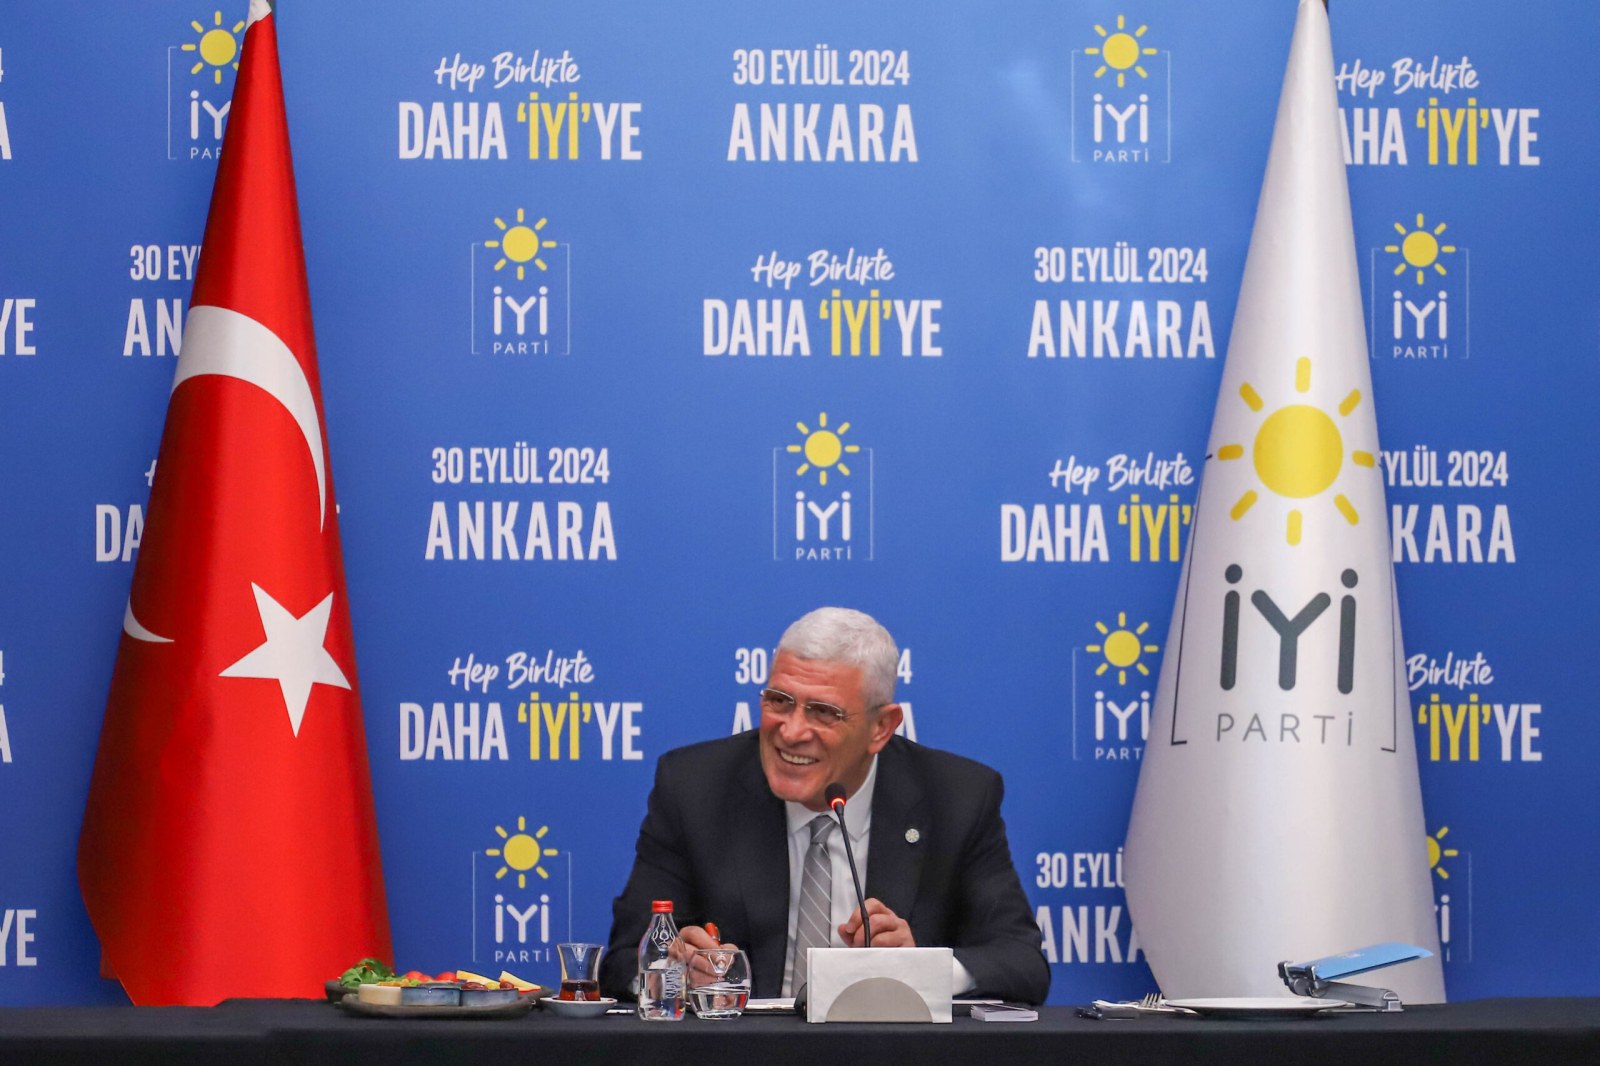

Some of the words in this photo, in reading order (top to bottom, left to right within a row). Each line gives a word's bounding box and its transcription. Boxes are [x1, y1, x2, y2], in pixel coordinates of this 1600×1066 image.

[434, 53, 486, 93] Hep
[492, 49, 581, 90] Birlikte
[733, 49, 766, 86] 30
[771, 43, 845, 86] EYLÜL
[849, 49, 911, 86] 2024
[1335, 58, 1386, 98] Hep
[1391, 55, 1480, 95] Birlikte
[190, 90, 232, 140] İY
[399, 101, 508, 160] DAHA
[727, 102, 920, 163] ANKARA
[1338, 107, 1408, 166] HA
[130, 244, 162, 281] 30
[751, 251, 802, 290] Hep
[808, 248, 896, 287] Birlikte
[1034, 247, 1067, 283] 30
[1071, 241, 1144, 284] EYLÜL
[1148, 247, 1208, 283] 2024
[703, 299, 812, 357] DAHA
[1028, 299, 1216, 359] ANKARA
[432, 447, 464, 484] 30
[470, 441, 544, 484] EYLÜL
[549, 447, 611, 485] 2024
[1049, 455, 1101, 496] Hep
[1106, 452, 1195, 491] Birlikte
[1380, 445, 1444, 487] YLÜL
[1447, 450, 1509, 487] 2024
[96, 504, 144, 562] DA
[425, 501, 618, 561] ANKARA
[1001, 504, 1110, 562] DAHA
[1117, 494, 1193, 562] ‘İYİ’
[1392, 504, 1516, 563] KARA
[448, 654, 500, 694] Hep
[506, 650, 595, 690] Birlikte
[736, 648, 768, 685] 30
[1406, 651, 1494, 691] Birlikte
[400, 702, 509, 761] DAHA
[1095, 747, 1142, 761] PART
[1036, 852, 1068, 888] 30
[1073, 846, 1125, 888] EYL
